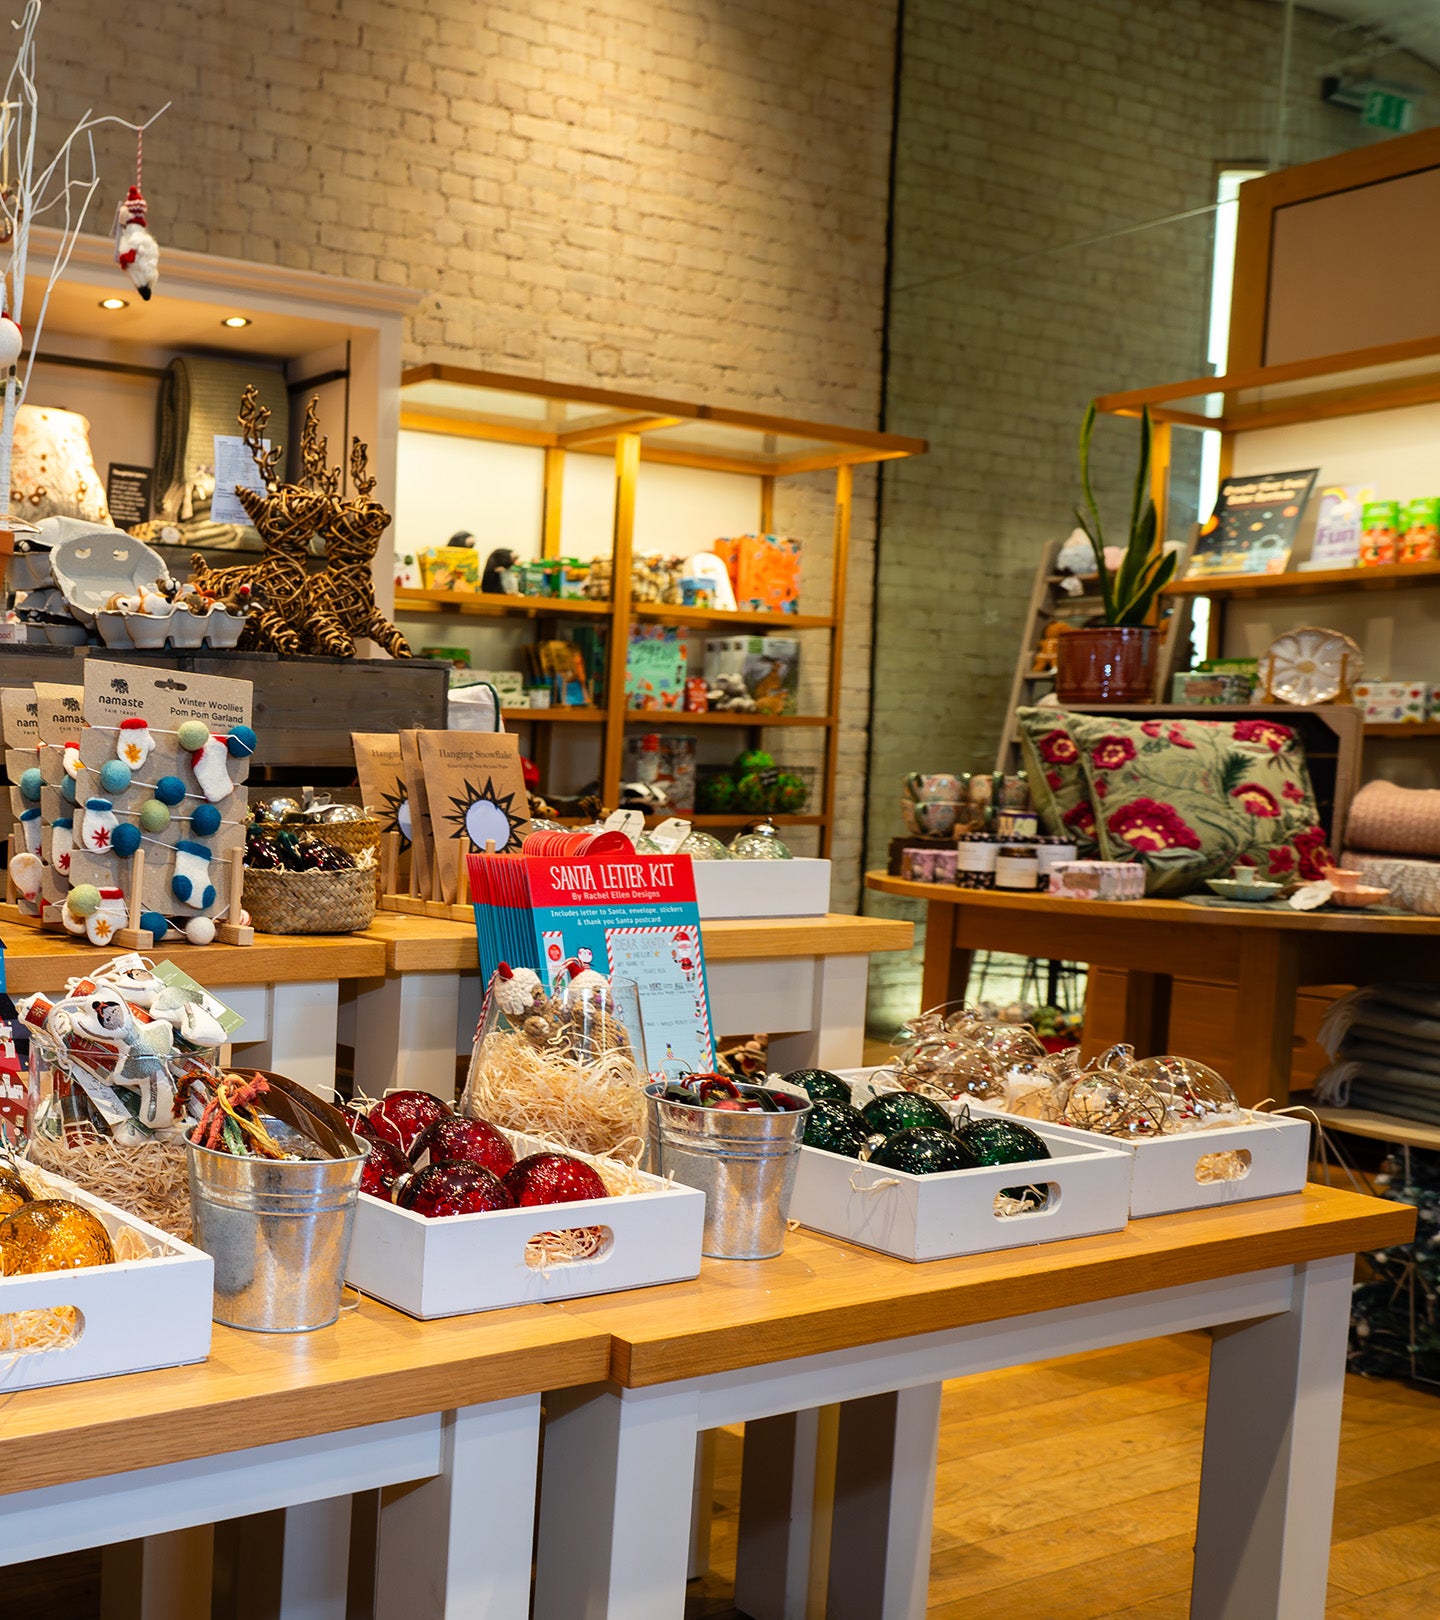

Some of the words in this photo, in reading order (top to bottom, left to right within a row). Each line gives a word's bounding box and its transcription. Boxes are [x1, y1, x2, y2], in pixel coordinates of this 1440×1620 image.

[1316, 526, 1355, 546] Fun
[98, 694, 145, 709] namaste
[178, 697, 206, 708] Winter
[208, 700, 244, 713] Woollies
[52, 713, 86, 724] namas
[119, 709, 137, 717] TRADE
[170, 707, 189, 717] Pom
[190, 709, 210, 720] Pom
[211, 712, 244, 724] Garland
[438, 749, 474, 761] Hanging
[475, 749, 513, 760] Snowflake
[549, 864, 597, 891] SANTA
[600, 863, 648, 890] LETTER
[648, 863, 675, 888] KIT
[572, 892, 582, 901] By
[584, 890, 609, 900] Rachel
[611, 890, 631, 900] Ellen
[632, 890, 661, 900] Designs
[550, 909, 579, 918] Includes
[580, 908, 599, 916] letter
[659, 906, 683, 914] stickers
[577, 918, 582, 926] &
[583, 917, 602, 926] thank
[603, 918, 615, 926] you
[615, 917, 634, 925] Santa
[634, 915, 662, 925] postcard
